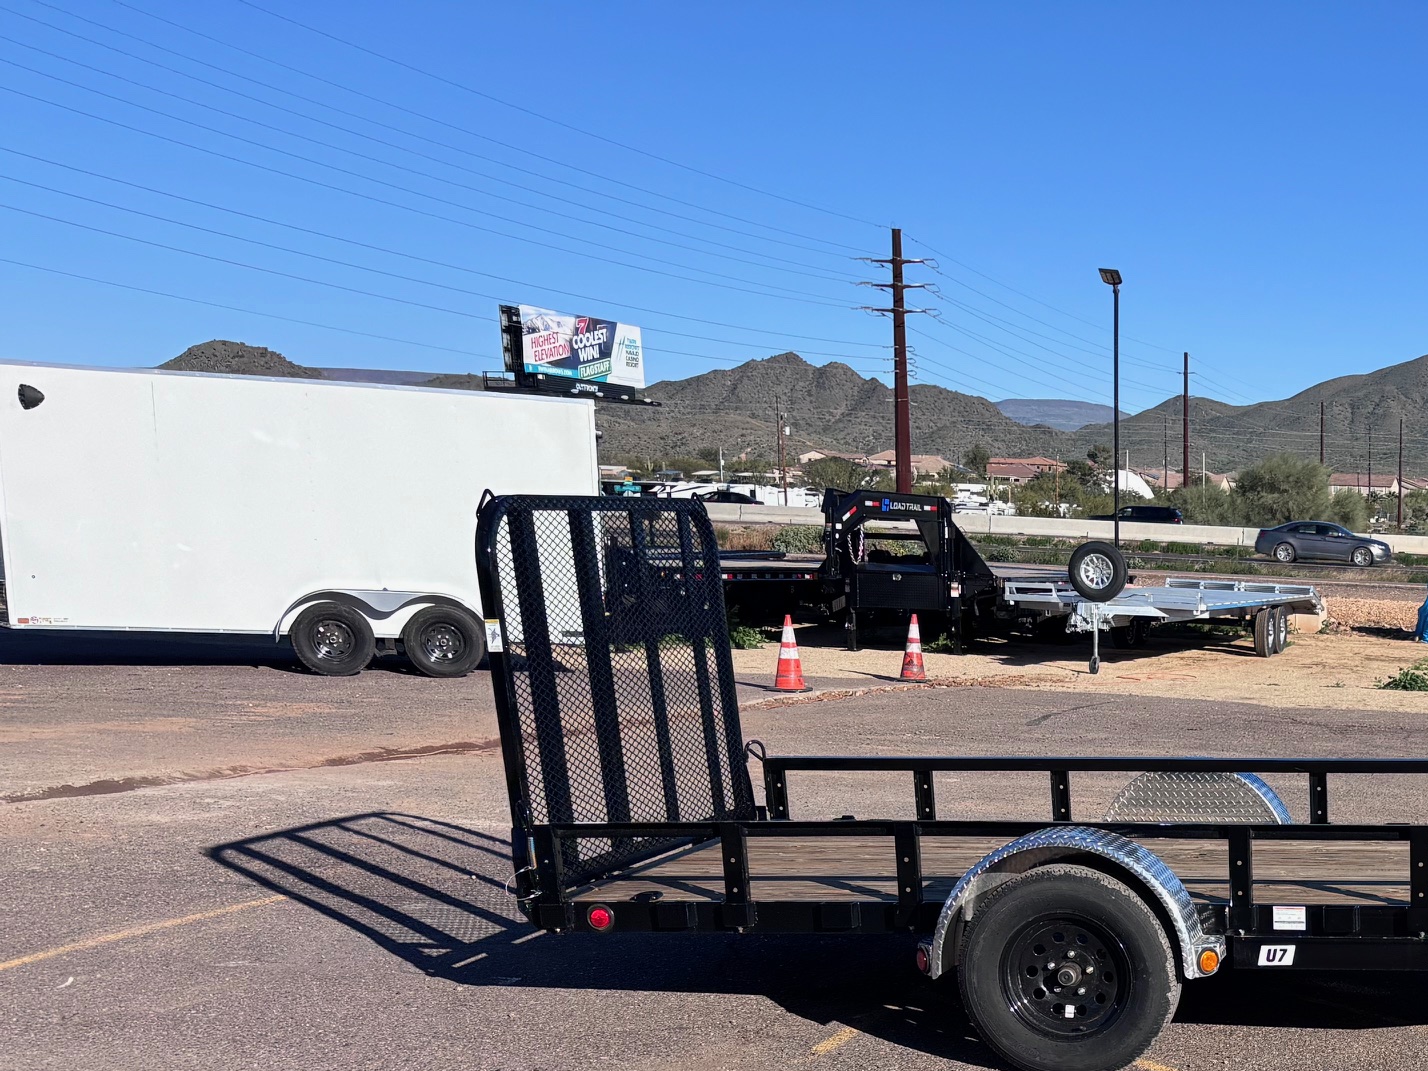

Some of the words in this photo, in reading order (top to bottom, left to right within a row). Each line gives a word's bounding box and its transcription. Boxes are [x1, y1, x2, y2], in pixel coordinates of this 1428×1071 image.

[576, 317, 589, 335] 7
[531, 332, 559, 349] HIGHEST
[573, 329, 607, 349] COOLEST
[534, 343, 571, 362] ELEVATION
[578, 345, 600, 362] WIN!
[580, 361, 610, 378] FLAGSTAFF
[1265, 948, 1288, 963] U7
